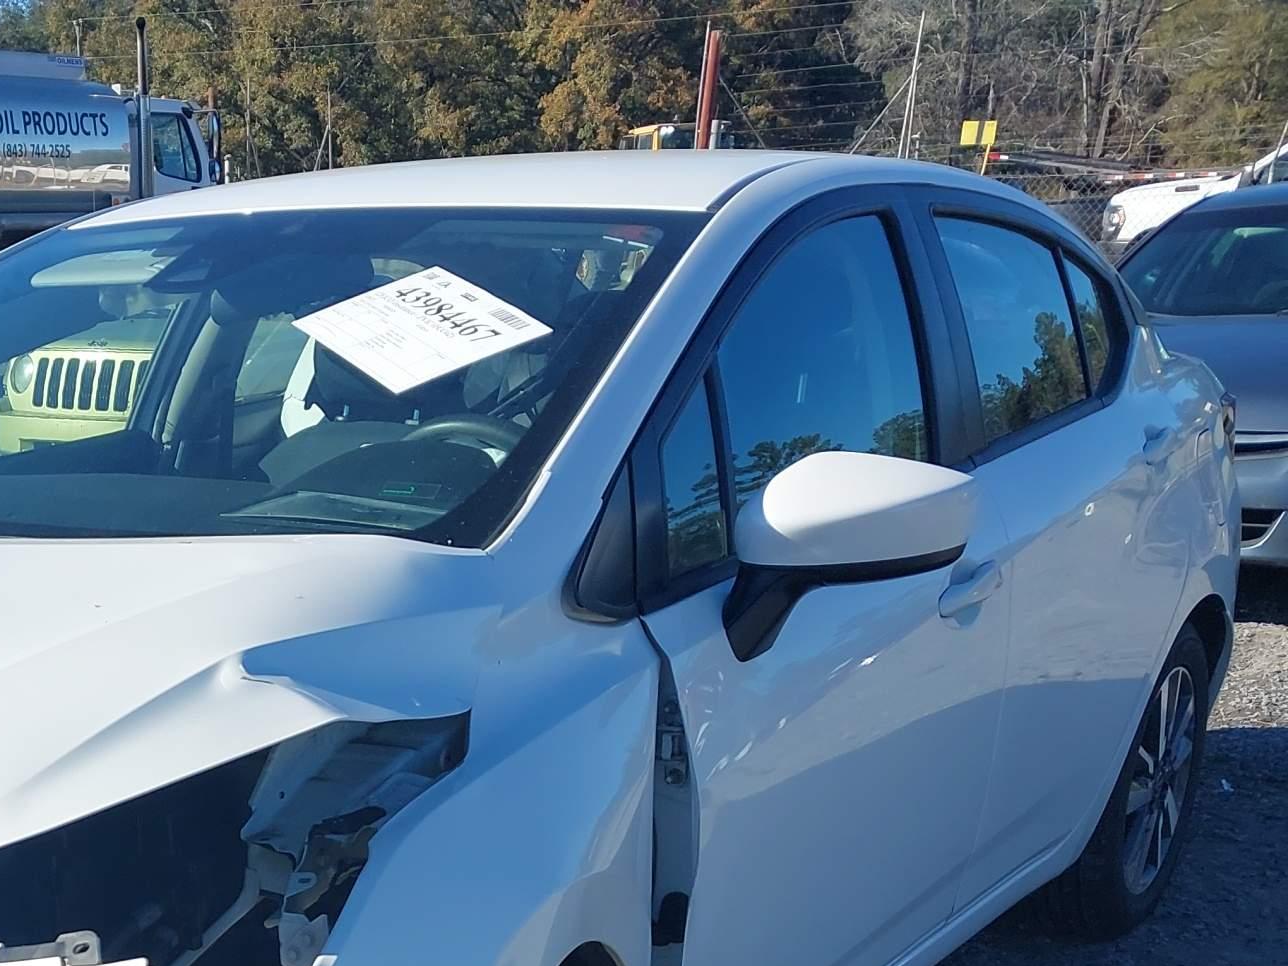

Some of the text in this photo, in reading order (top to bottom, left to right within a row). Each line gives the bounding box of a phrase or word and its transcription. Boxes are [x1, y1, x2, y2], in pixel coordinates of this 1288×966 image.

[21, 110, 109, 137] PRODUCTS
[2, 143, 71, 158] (843) 744-2525
[395, 287, 502, 343] 43984467
